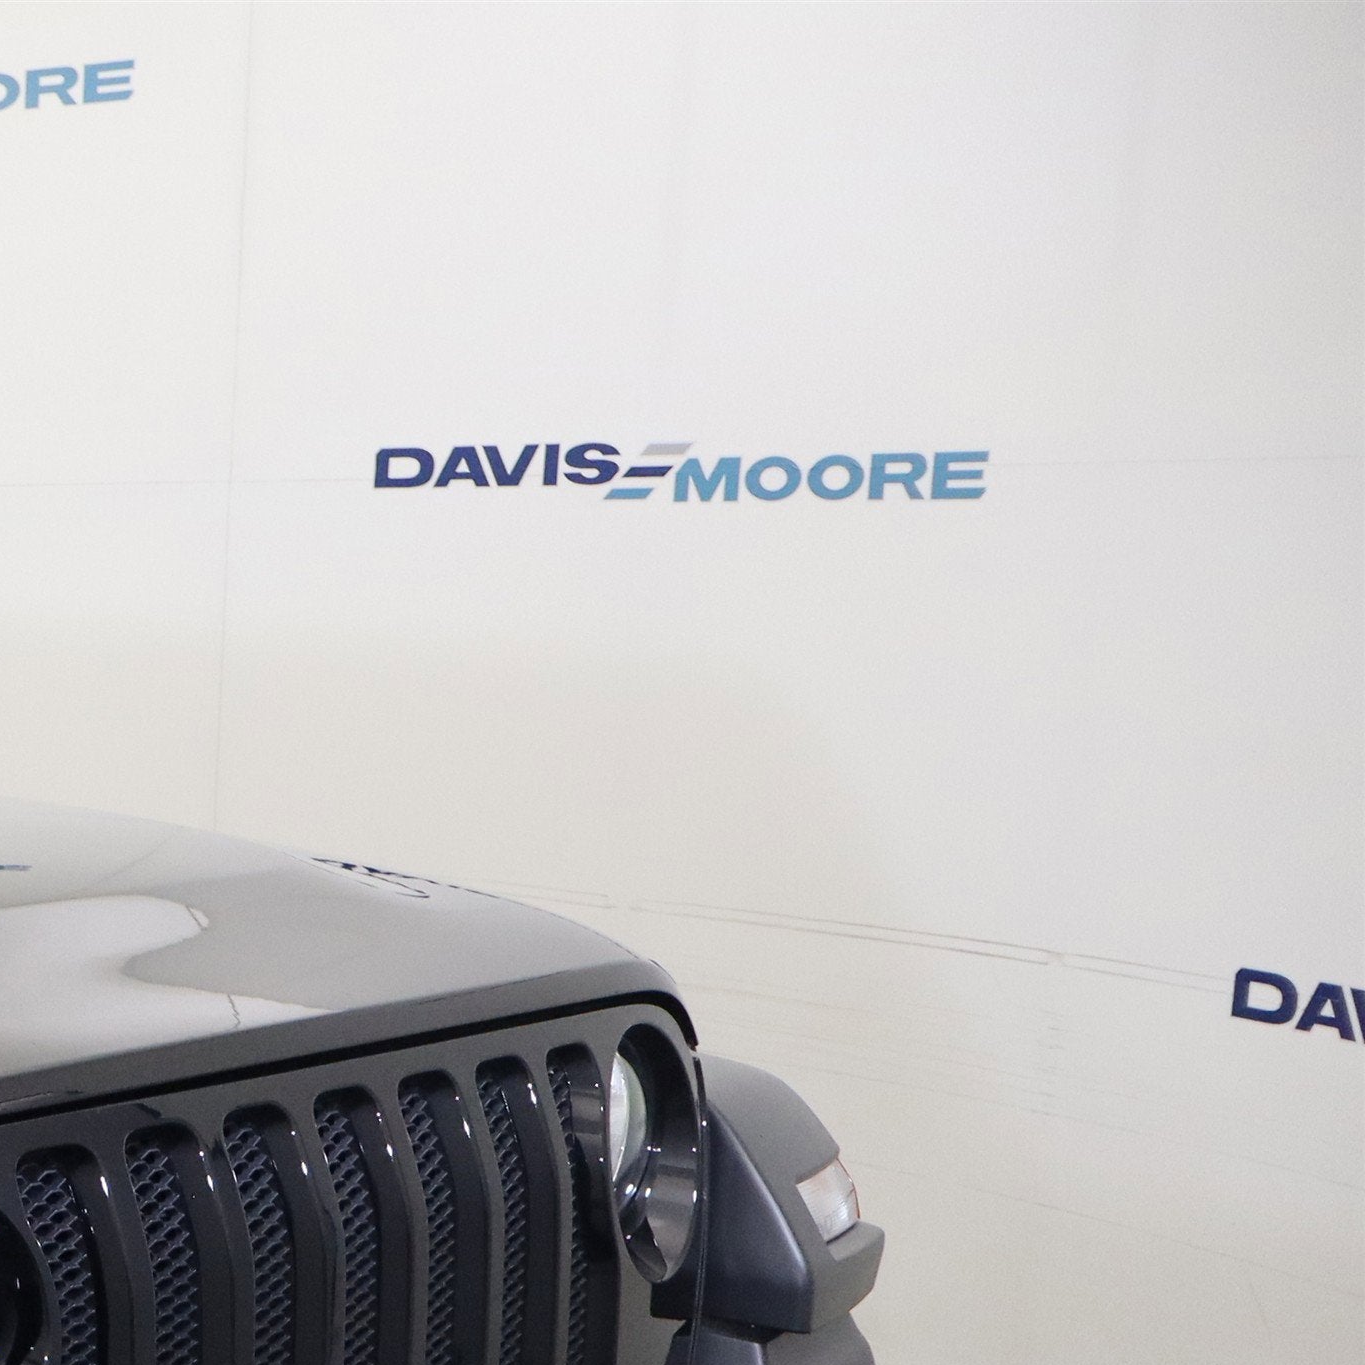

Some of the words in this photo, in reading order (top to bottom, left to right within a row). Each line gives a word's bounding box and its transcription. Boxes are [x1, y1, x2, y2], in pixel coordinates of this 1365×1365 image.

[374, 442, 621, 489] DAVIS
[673, 451, 991, 501] MOORE
[1231, 967, 1365, 1046] DA
